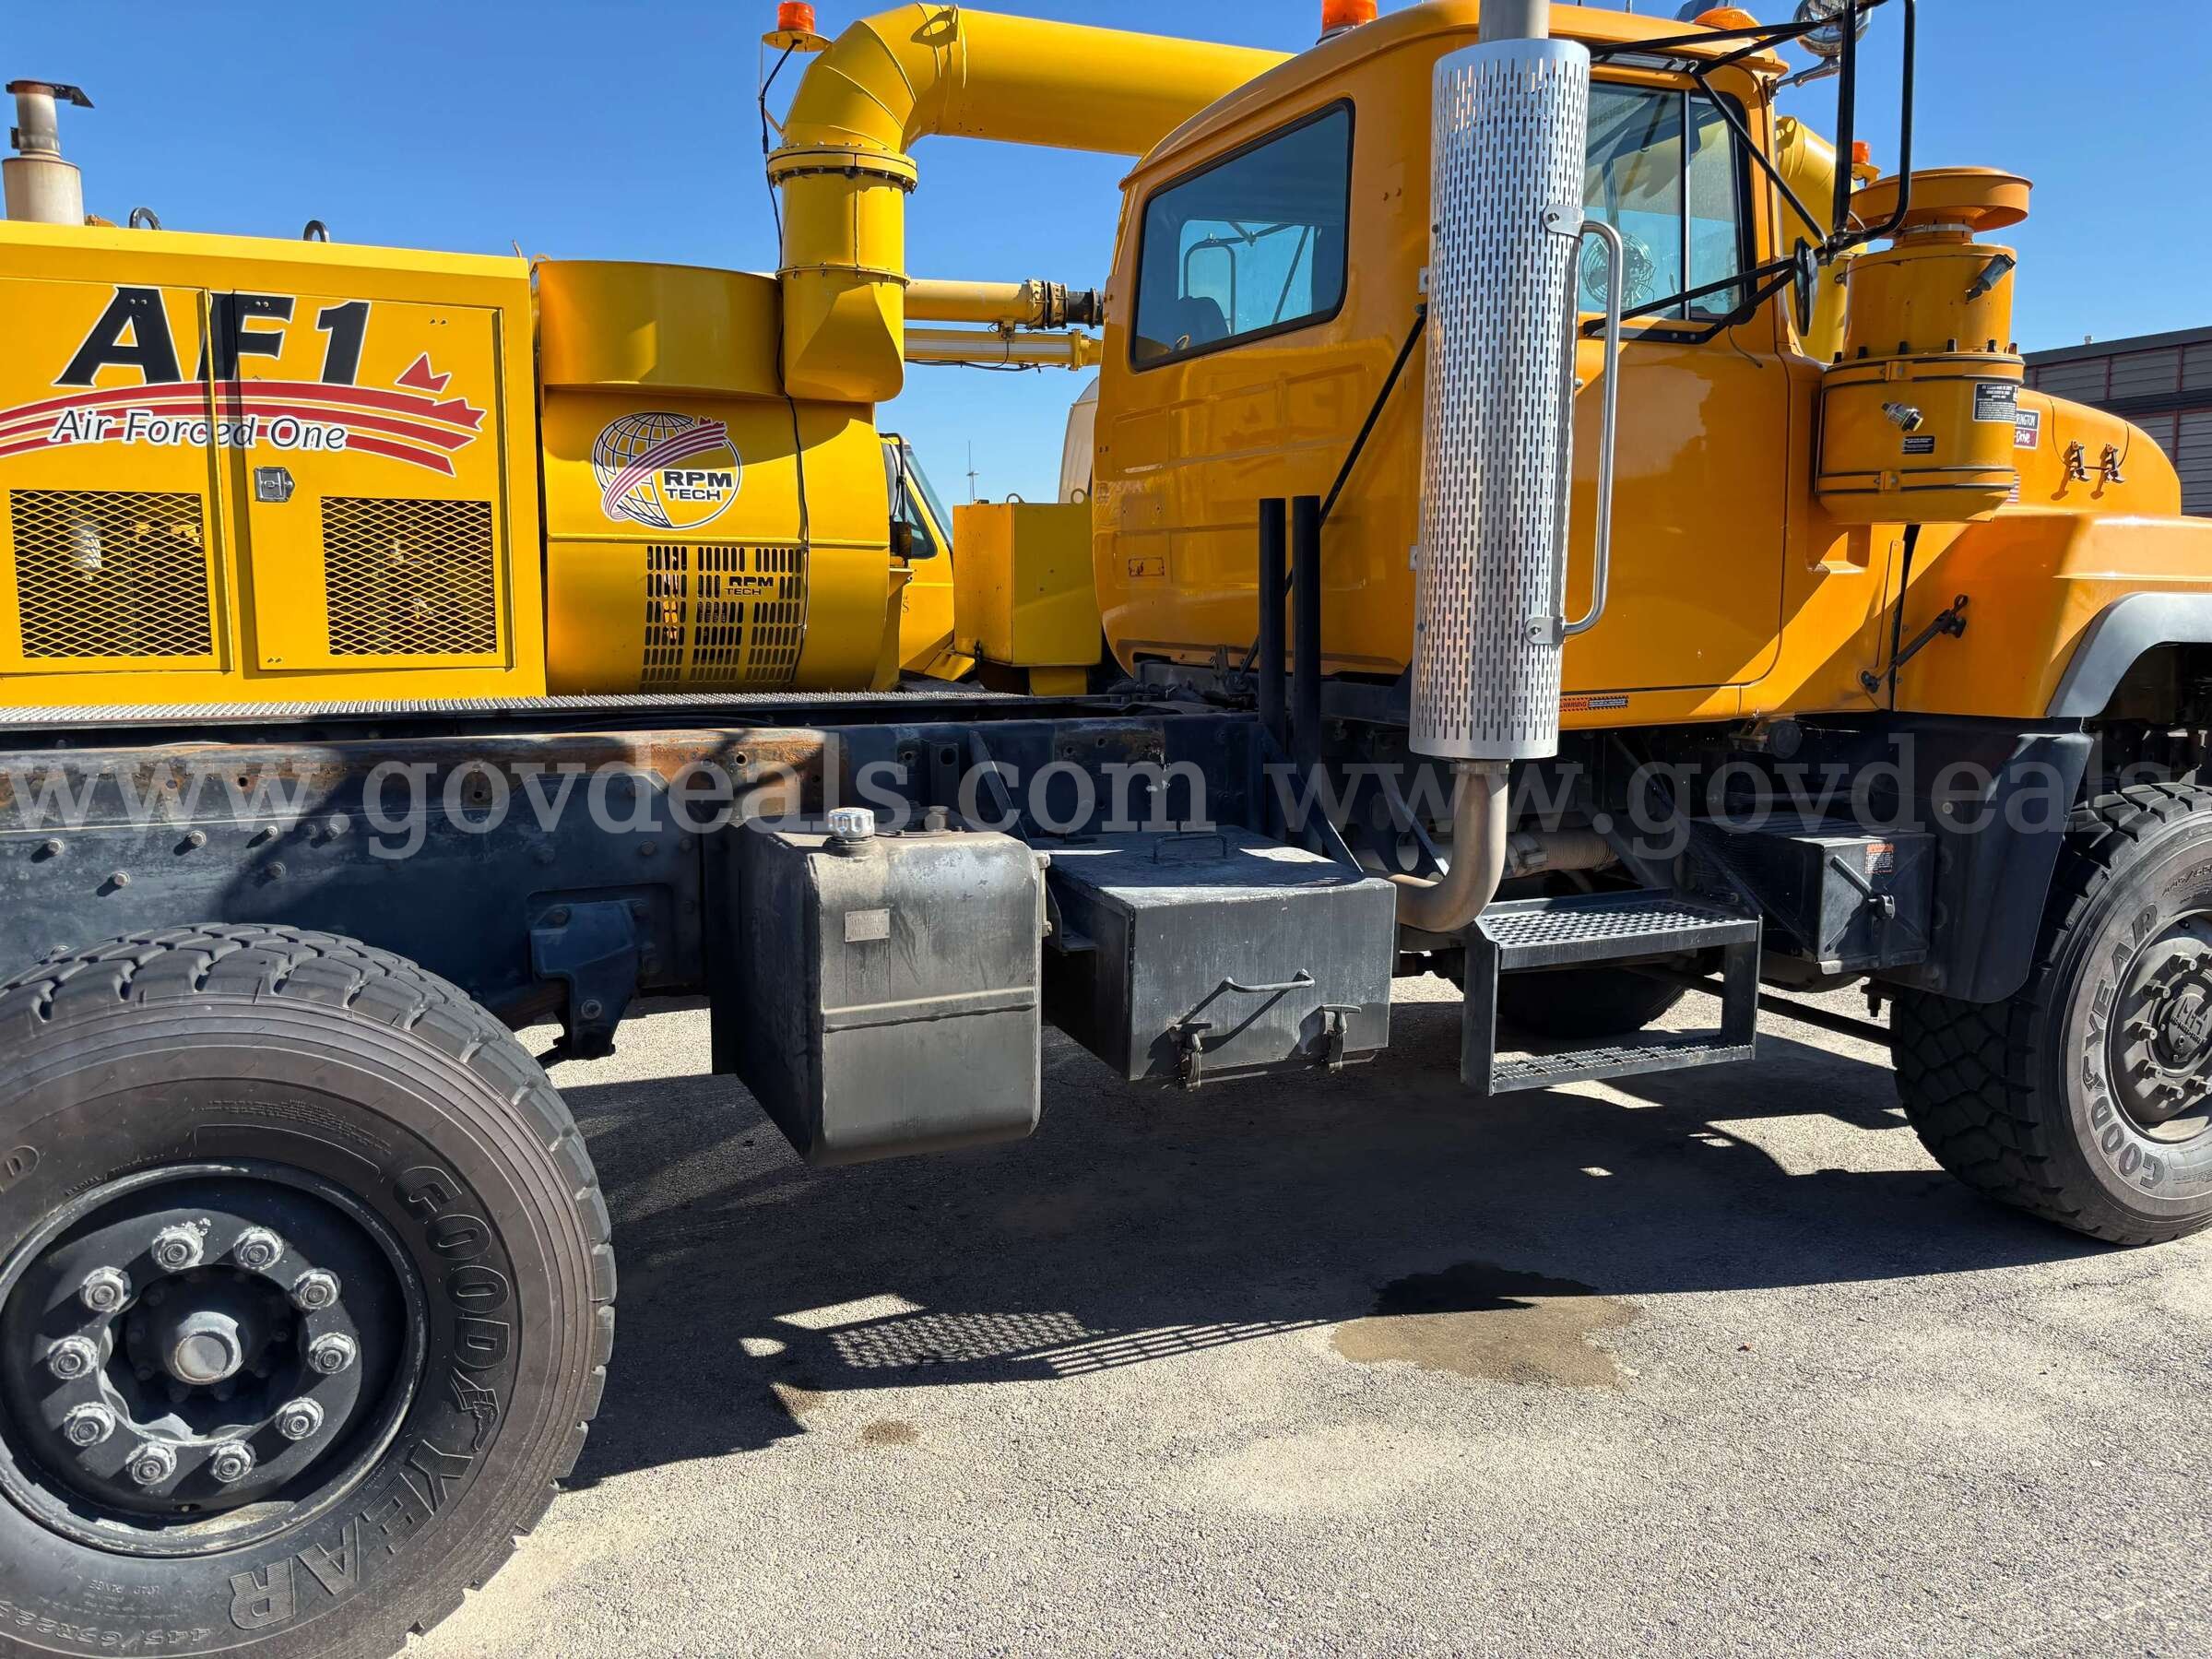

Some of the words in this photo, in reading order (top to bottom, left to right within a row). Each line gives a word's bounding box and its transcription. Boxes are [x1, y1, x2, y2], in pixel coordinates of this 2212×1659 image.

[53, 286, 371, 386] AF1
[53, 409, 111, 444] Air
[125, 411, 255, 449] Forced
[270, 417, 348, 451] One
[663, 469, 732, 488] RPM
[665, 488, 721, 501] TECH
[725, 587, 762, 596] TECH
[728, 575, 775, 587] RPM
[2084, 904, 2165, 1189] GOODYEAR
[229, 1166, 510, 1629] GOODYEAR
